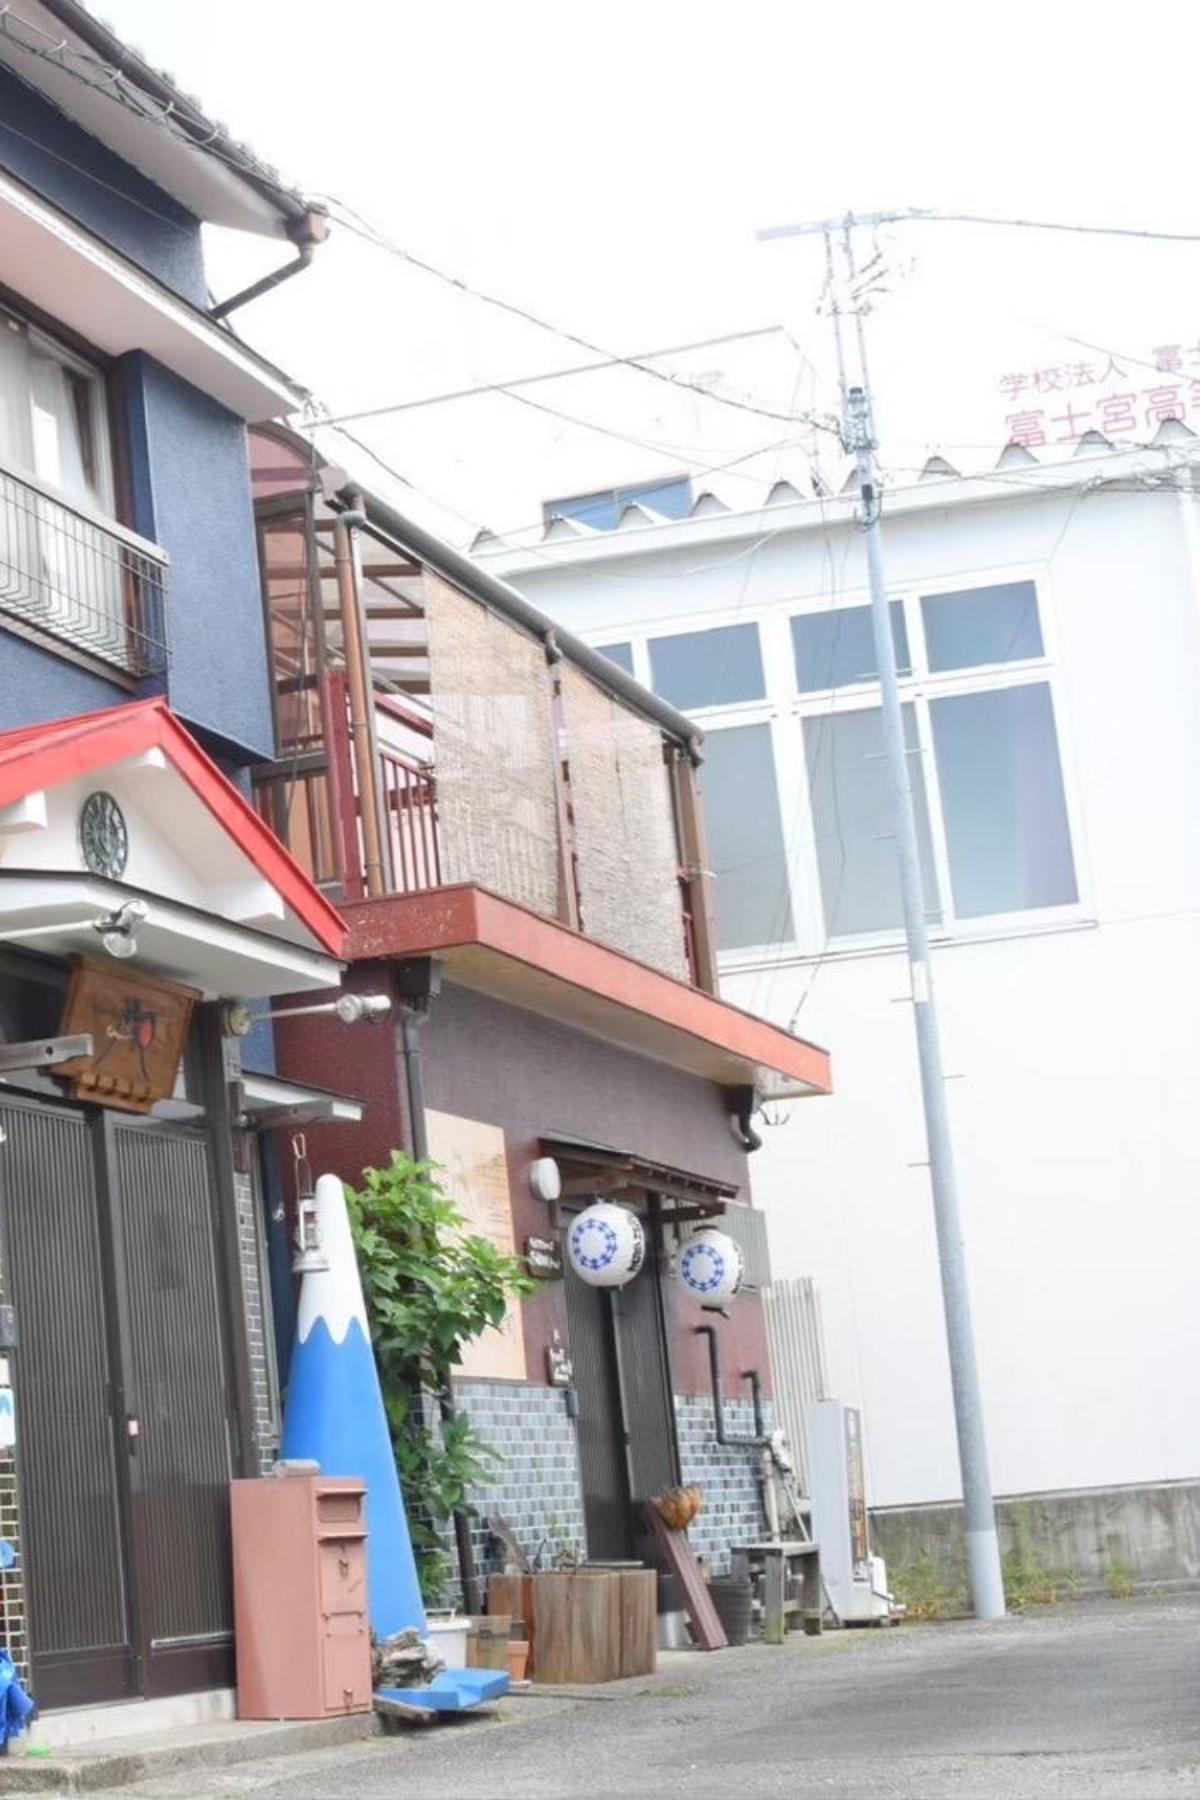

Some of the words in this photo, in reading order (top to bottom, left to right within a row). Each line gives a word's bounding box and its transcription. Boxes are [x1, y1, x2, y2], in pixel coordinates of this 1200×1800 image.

[999, 353, 1129, 400] 学校法人
[1005, 380, 1200, 447] 富士宮高
